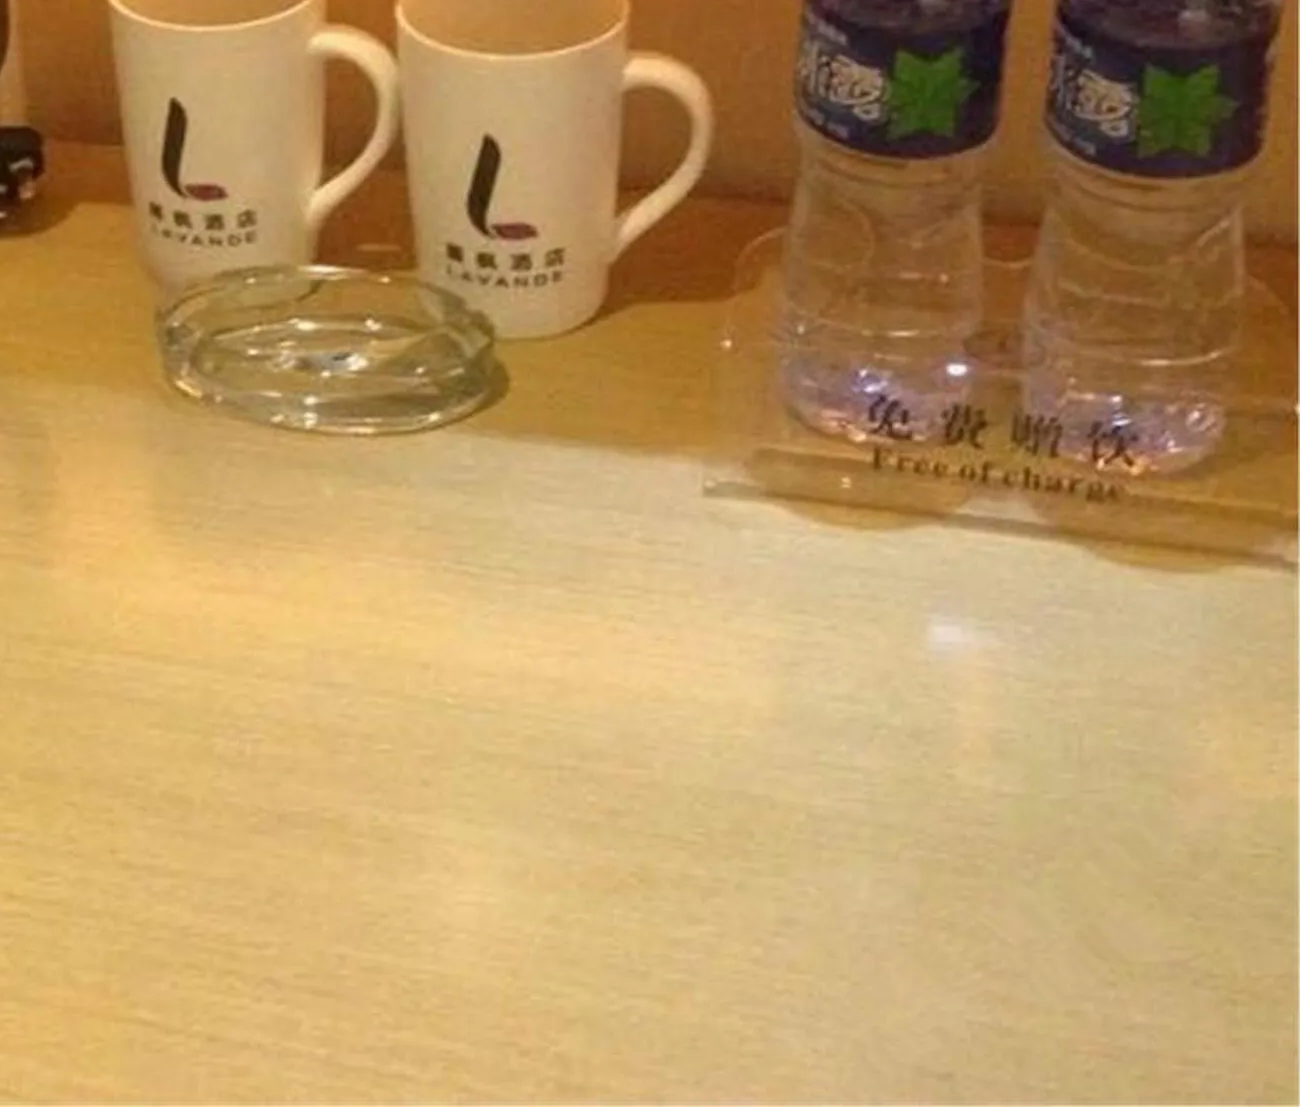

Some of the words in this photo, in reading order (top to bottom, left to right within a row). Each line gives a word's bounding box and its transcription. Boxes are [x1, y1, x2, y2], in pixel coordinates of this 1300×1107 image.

[446, 264, 563, 288] LAVANDE
[873, 446, 948, 479] Free
[959, 461, 991, 484] of
[1002, 466, 1122, 503] charge
